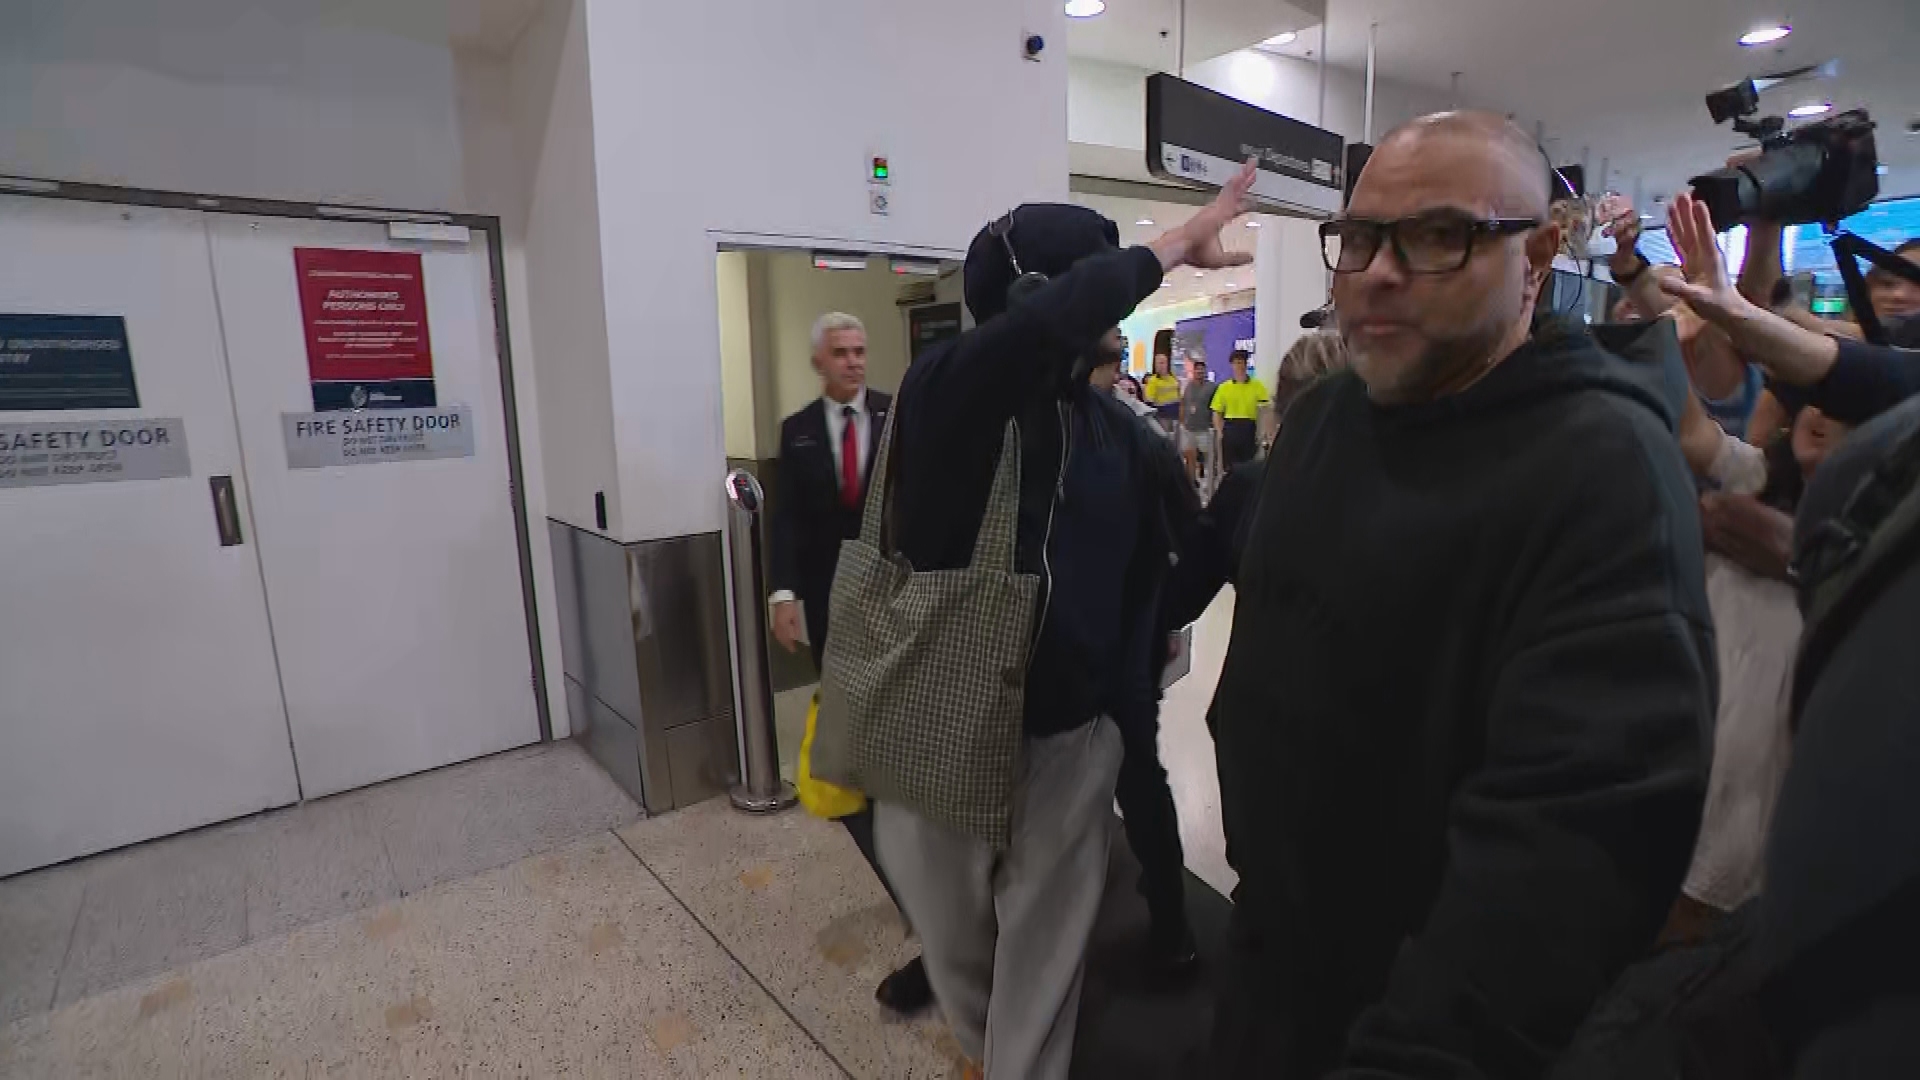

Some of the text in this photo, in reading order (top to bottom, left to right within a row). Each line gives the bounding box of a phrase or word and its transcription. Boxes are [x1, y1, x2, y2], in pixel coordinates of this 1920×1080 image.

[296, 413, 461, 437] FIRE SAFETY DOOR
[0, 427, 170, 451] SAFETY DOOR
